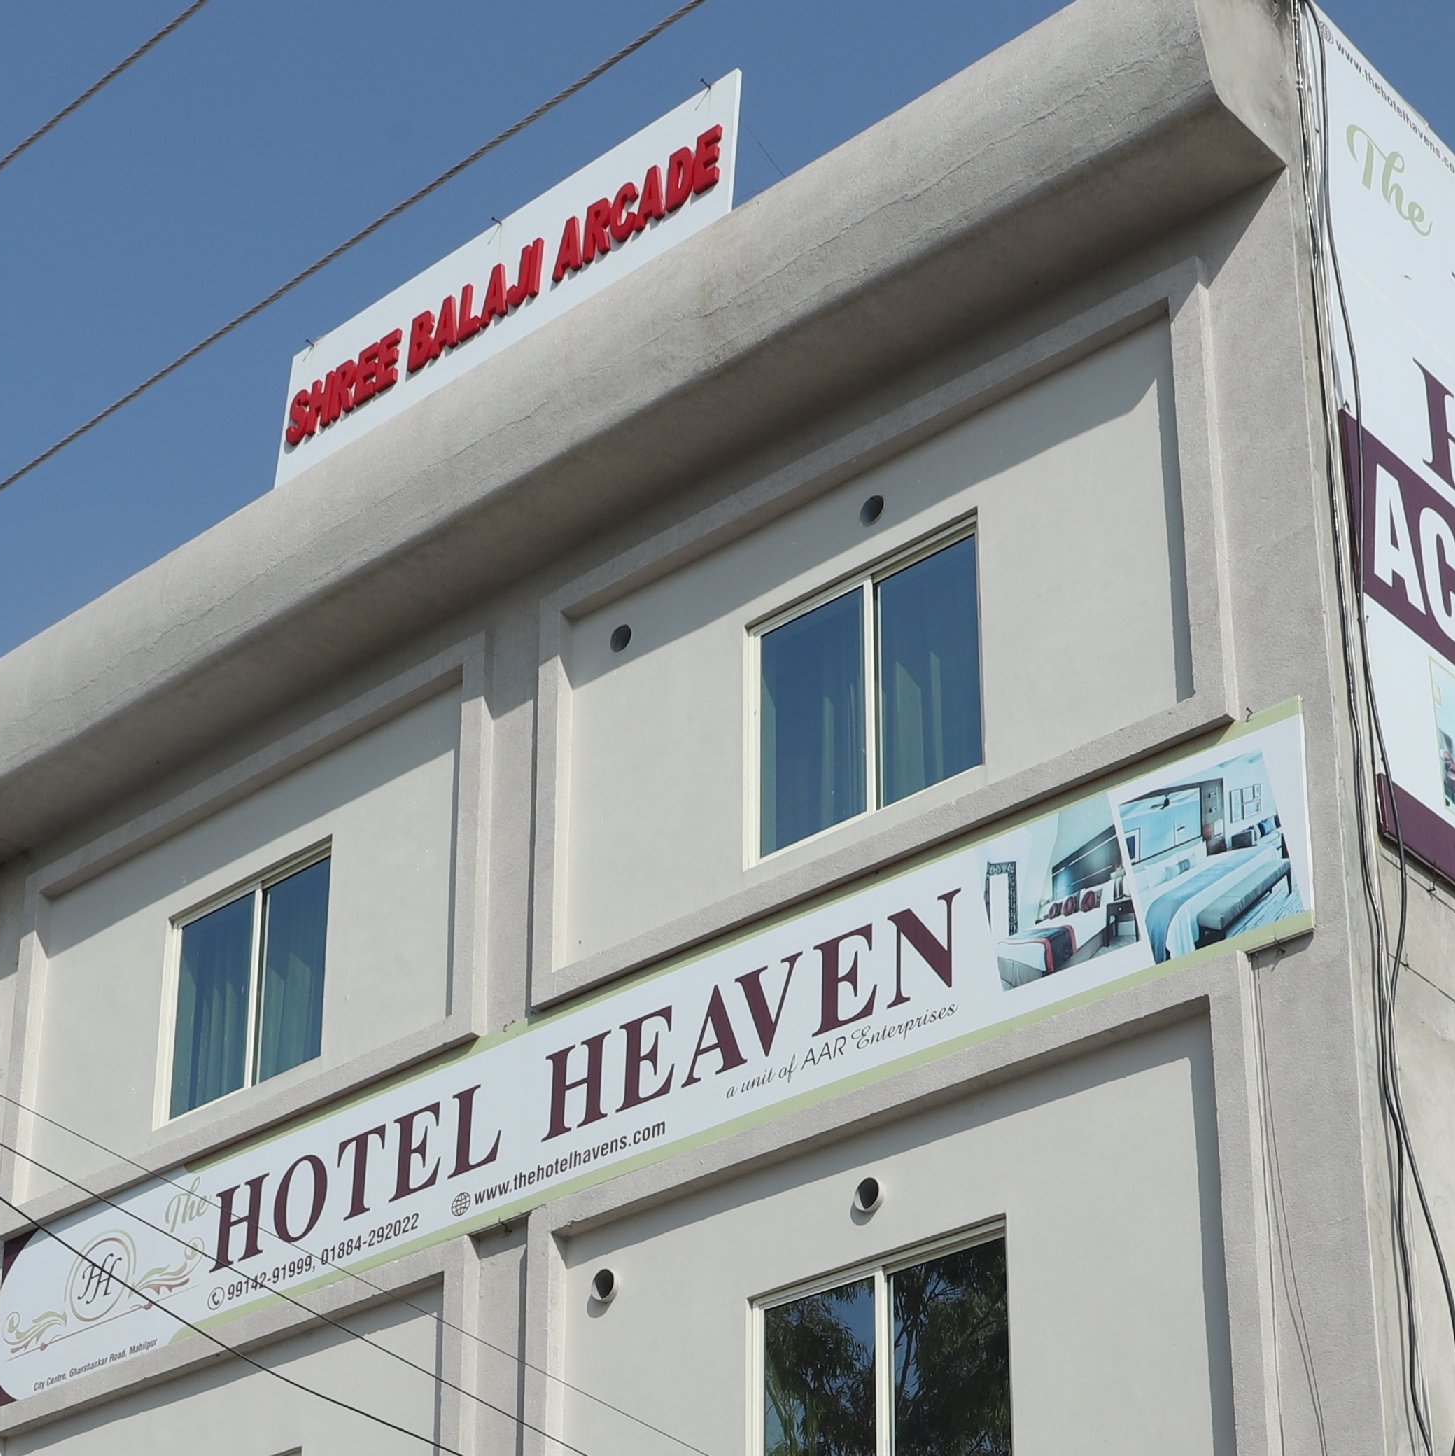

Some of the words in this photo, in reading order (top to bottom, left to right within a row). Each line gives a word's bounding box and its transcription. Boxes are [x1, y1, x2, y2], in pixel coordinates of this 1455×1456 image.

[1346, 123, 1433, 237] The
[285, 328, 403, 446] SHREE
[406, 237, 545, 373] BALAJI
[552, 123, 723, 283] ARCADE
[208, 1084, 502, 1273] HOTEL
[540, 887, 963, 1144] HEAVEN
[740, 1067, 775, 1094] unit
[778, 1053, 798, 1083] of
[800, 1035, 847, 1072] AAR
[850, 1003, 960, 1050] Enterprises
[164, 1176, 213, 1233] The
[472, 1119, 667, 1207] www.thehotelhavens.com
[320, 1212, 421, 1266] 01884-292022
[33, 1378, 45, 1391] City
[69, 1356, 108, 1377] Gharshankar
